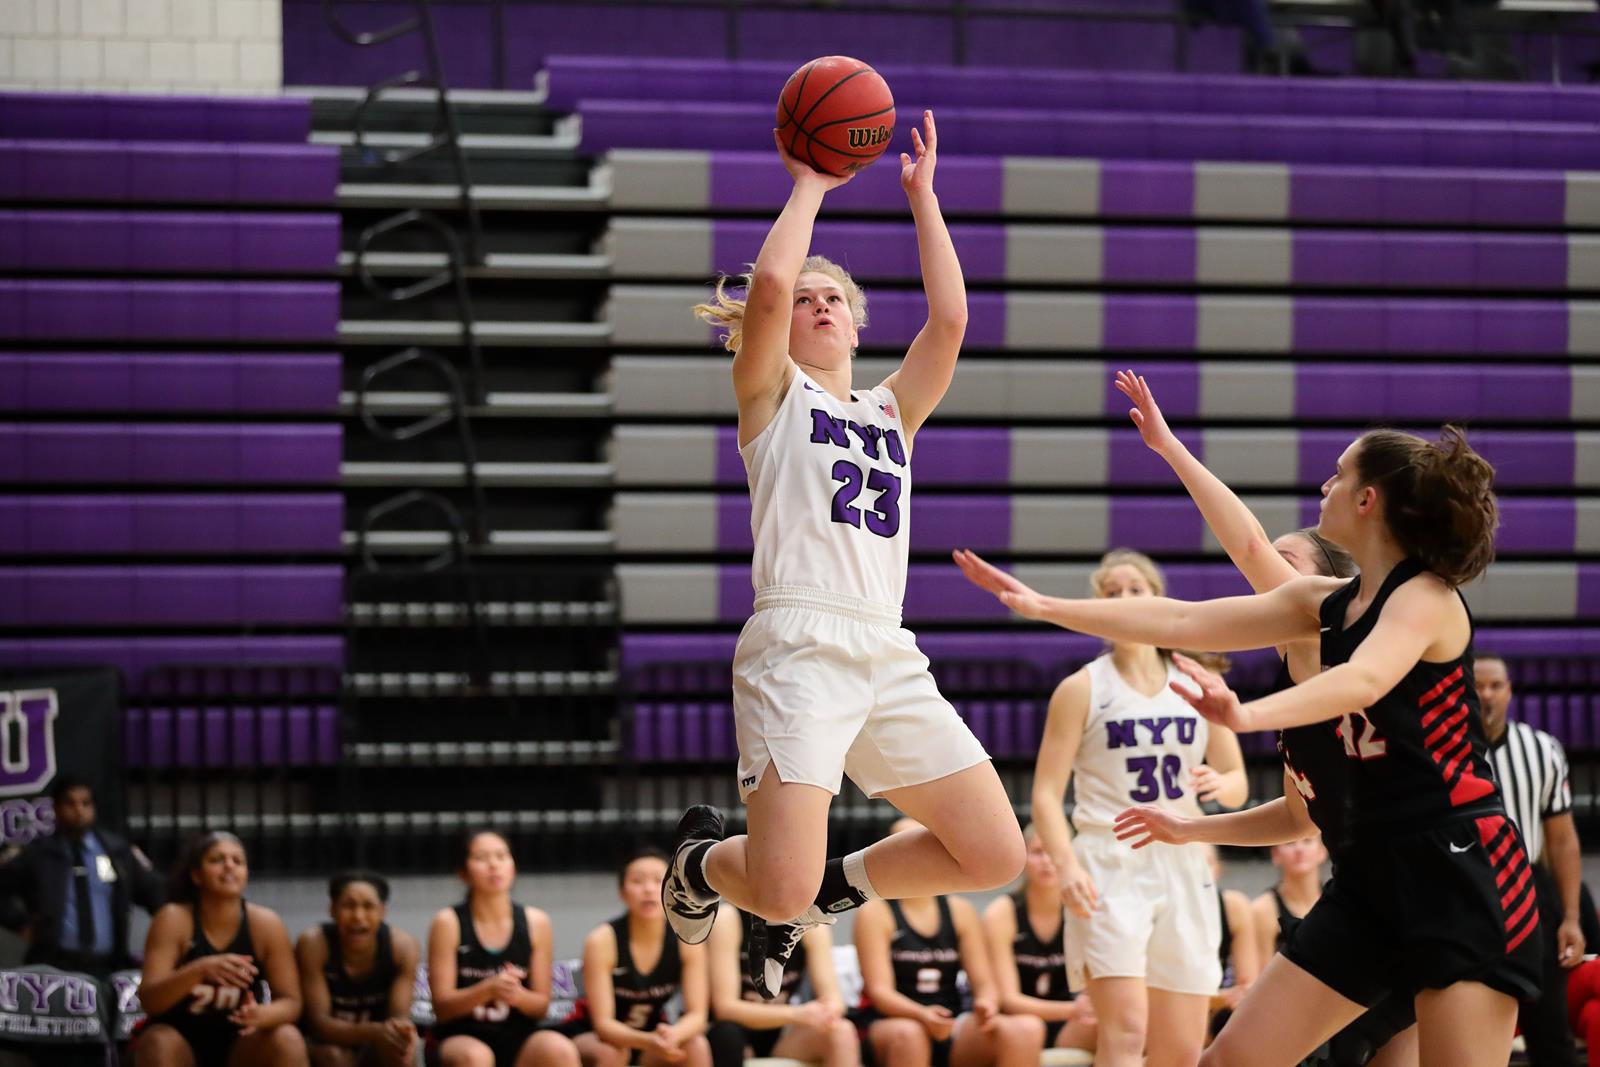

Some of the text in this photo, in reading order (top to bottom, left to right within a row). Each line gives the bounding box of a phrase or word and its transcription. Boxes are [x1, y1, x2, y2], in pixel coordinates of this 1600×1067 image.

[810, 408, 906, 468] NYU
[831, 460, 902, 538] 23
[1105, 717, 1197, 750] NYU
[1126, 754, 1184, 803] 30
